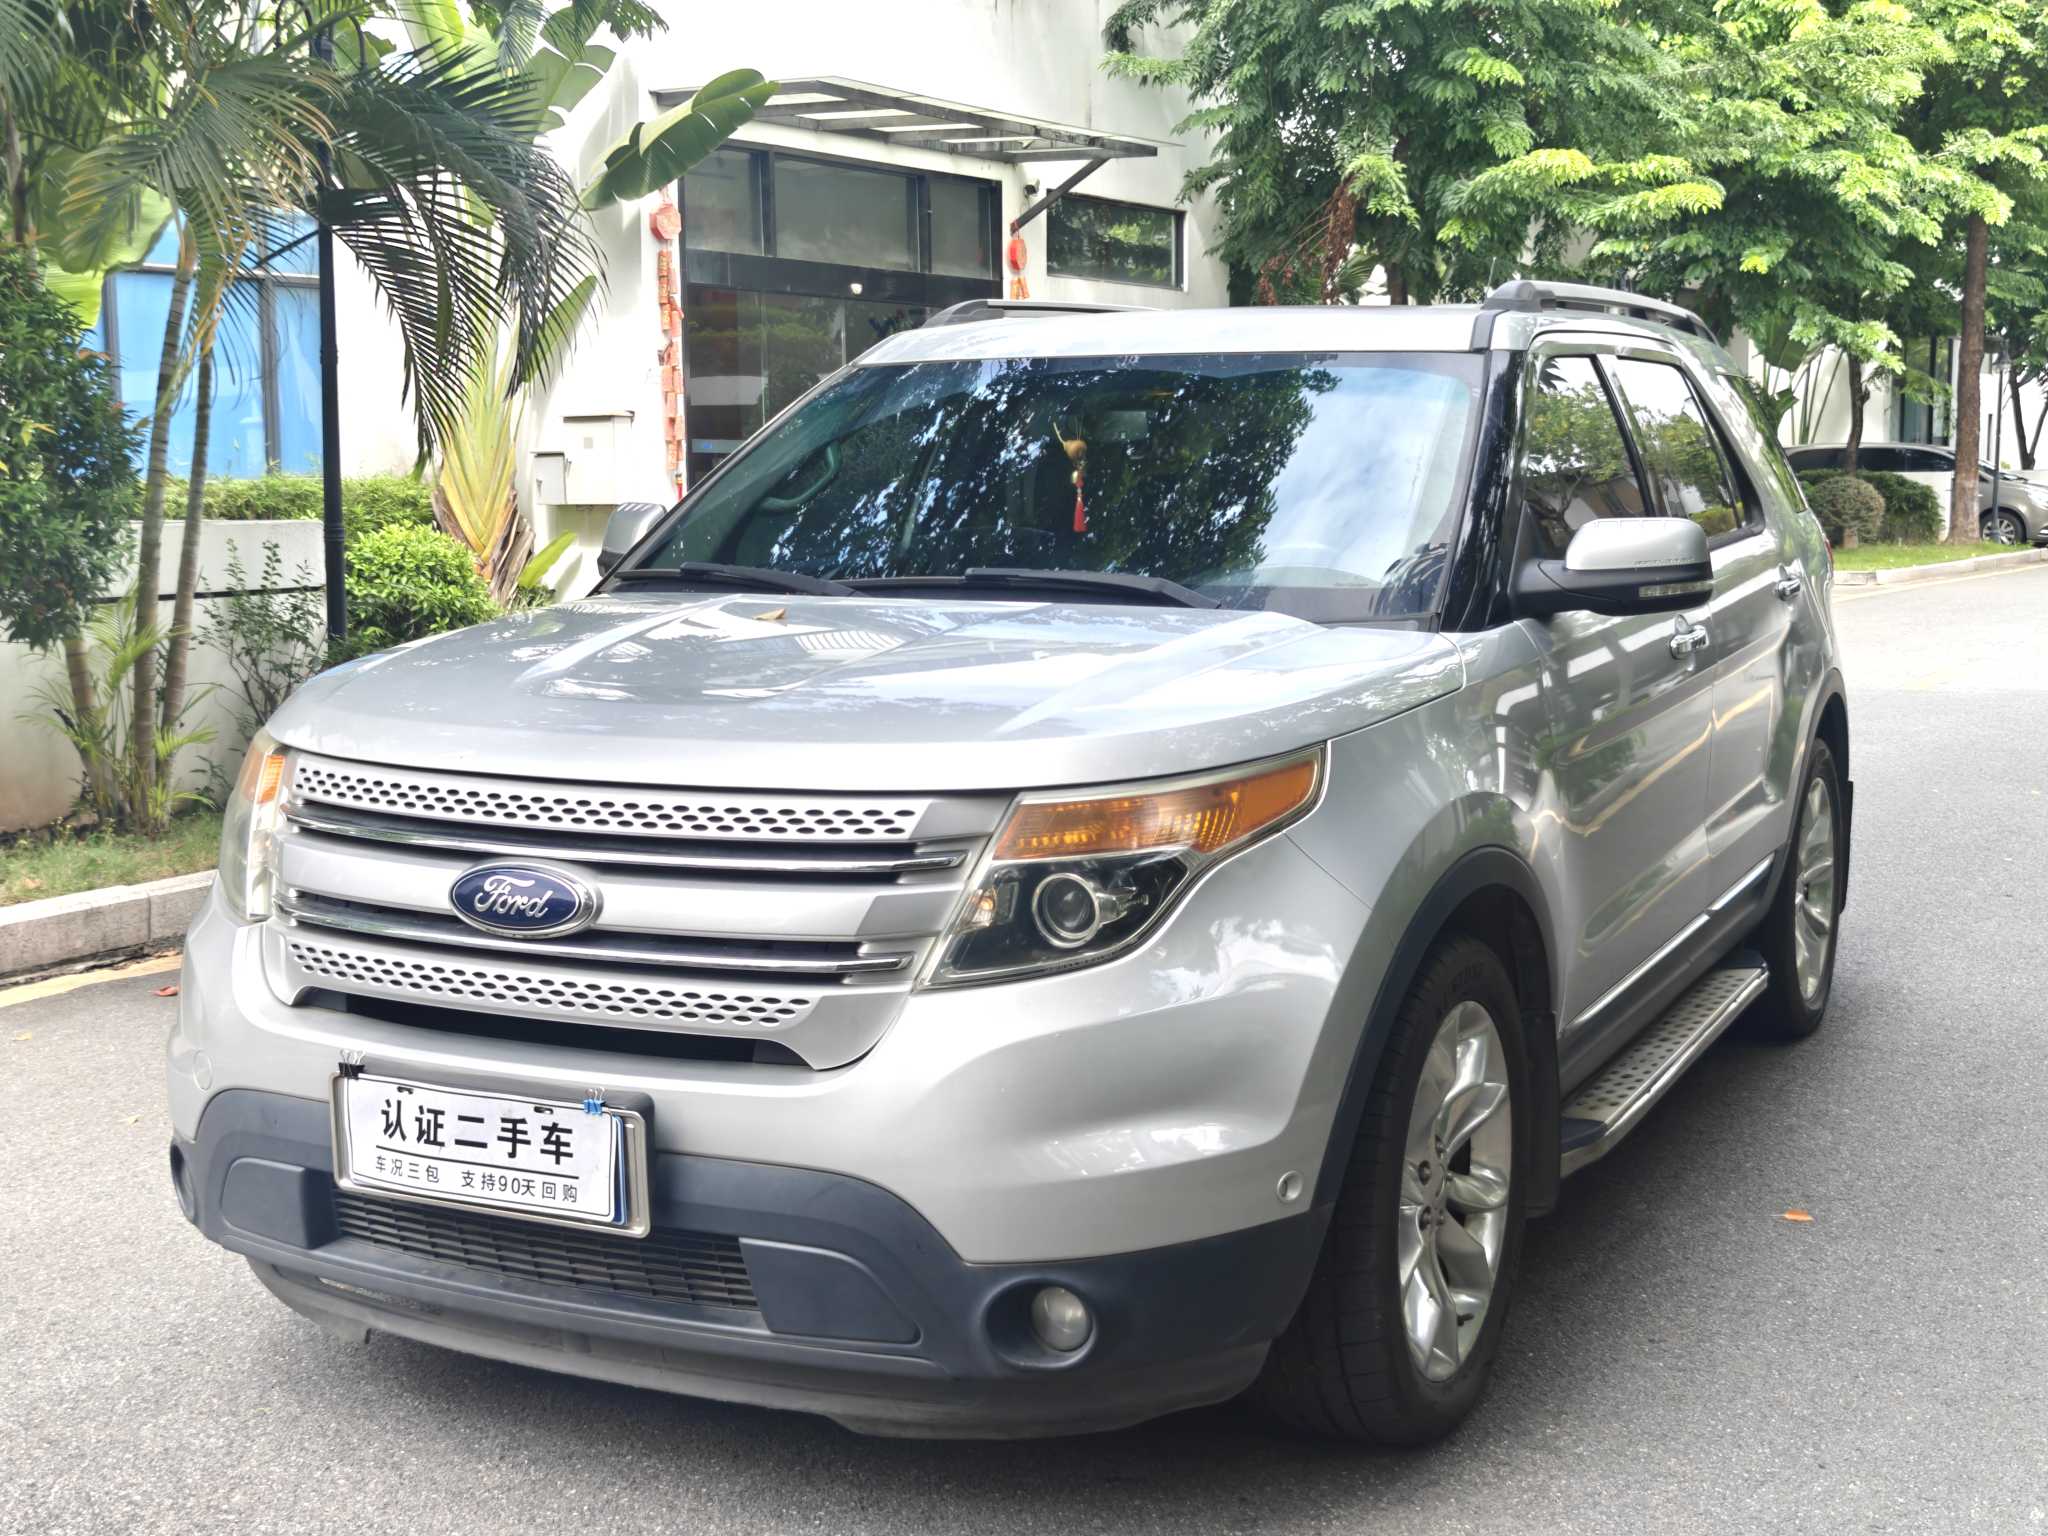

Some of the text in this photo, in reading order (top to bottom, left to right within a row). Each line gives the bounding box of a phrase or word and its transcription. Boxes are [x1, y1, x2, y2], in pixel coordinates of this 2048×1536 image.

[474, 875, 553, 918] Ford
[380, 1099, 574, 1166] 认证二手车
[374, 1155, 578, 1203] 车况三包 支持90天回购
